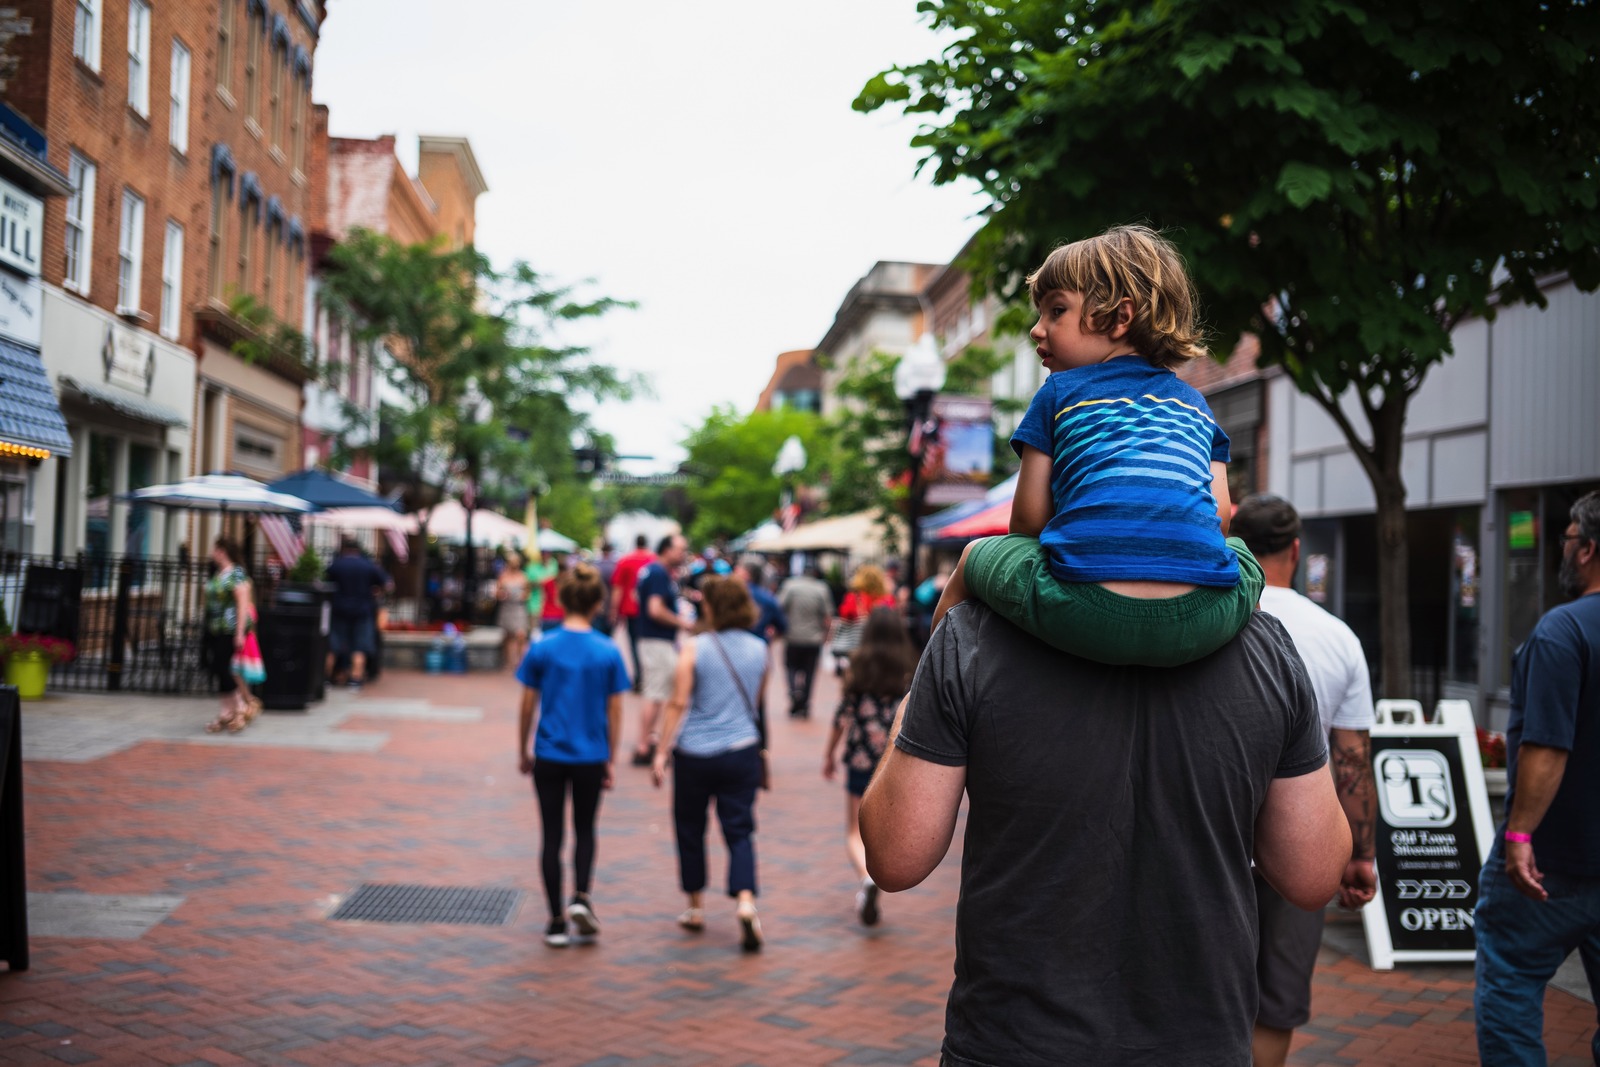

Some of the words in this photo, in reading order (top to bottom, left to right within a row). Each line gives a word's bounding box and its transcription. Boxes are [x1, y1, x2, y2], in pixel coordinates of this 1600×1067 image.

[1391, 830, 1417, 845] Old
[1418, 830, 1456, 845] Town
[1400, 907, 1475, 931] OPEN
